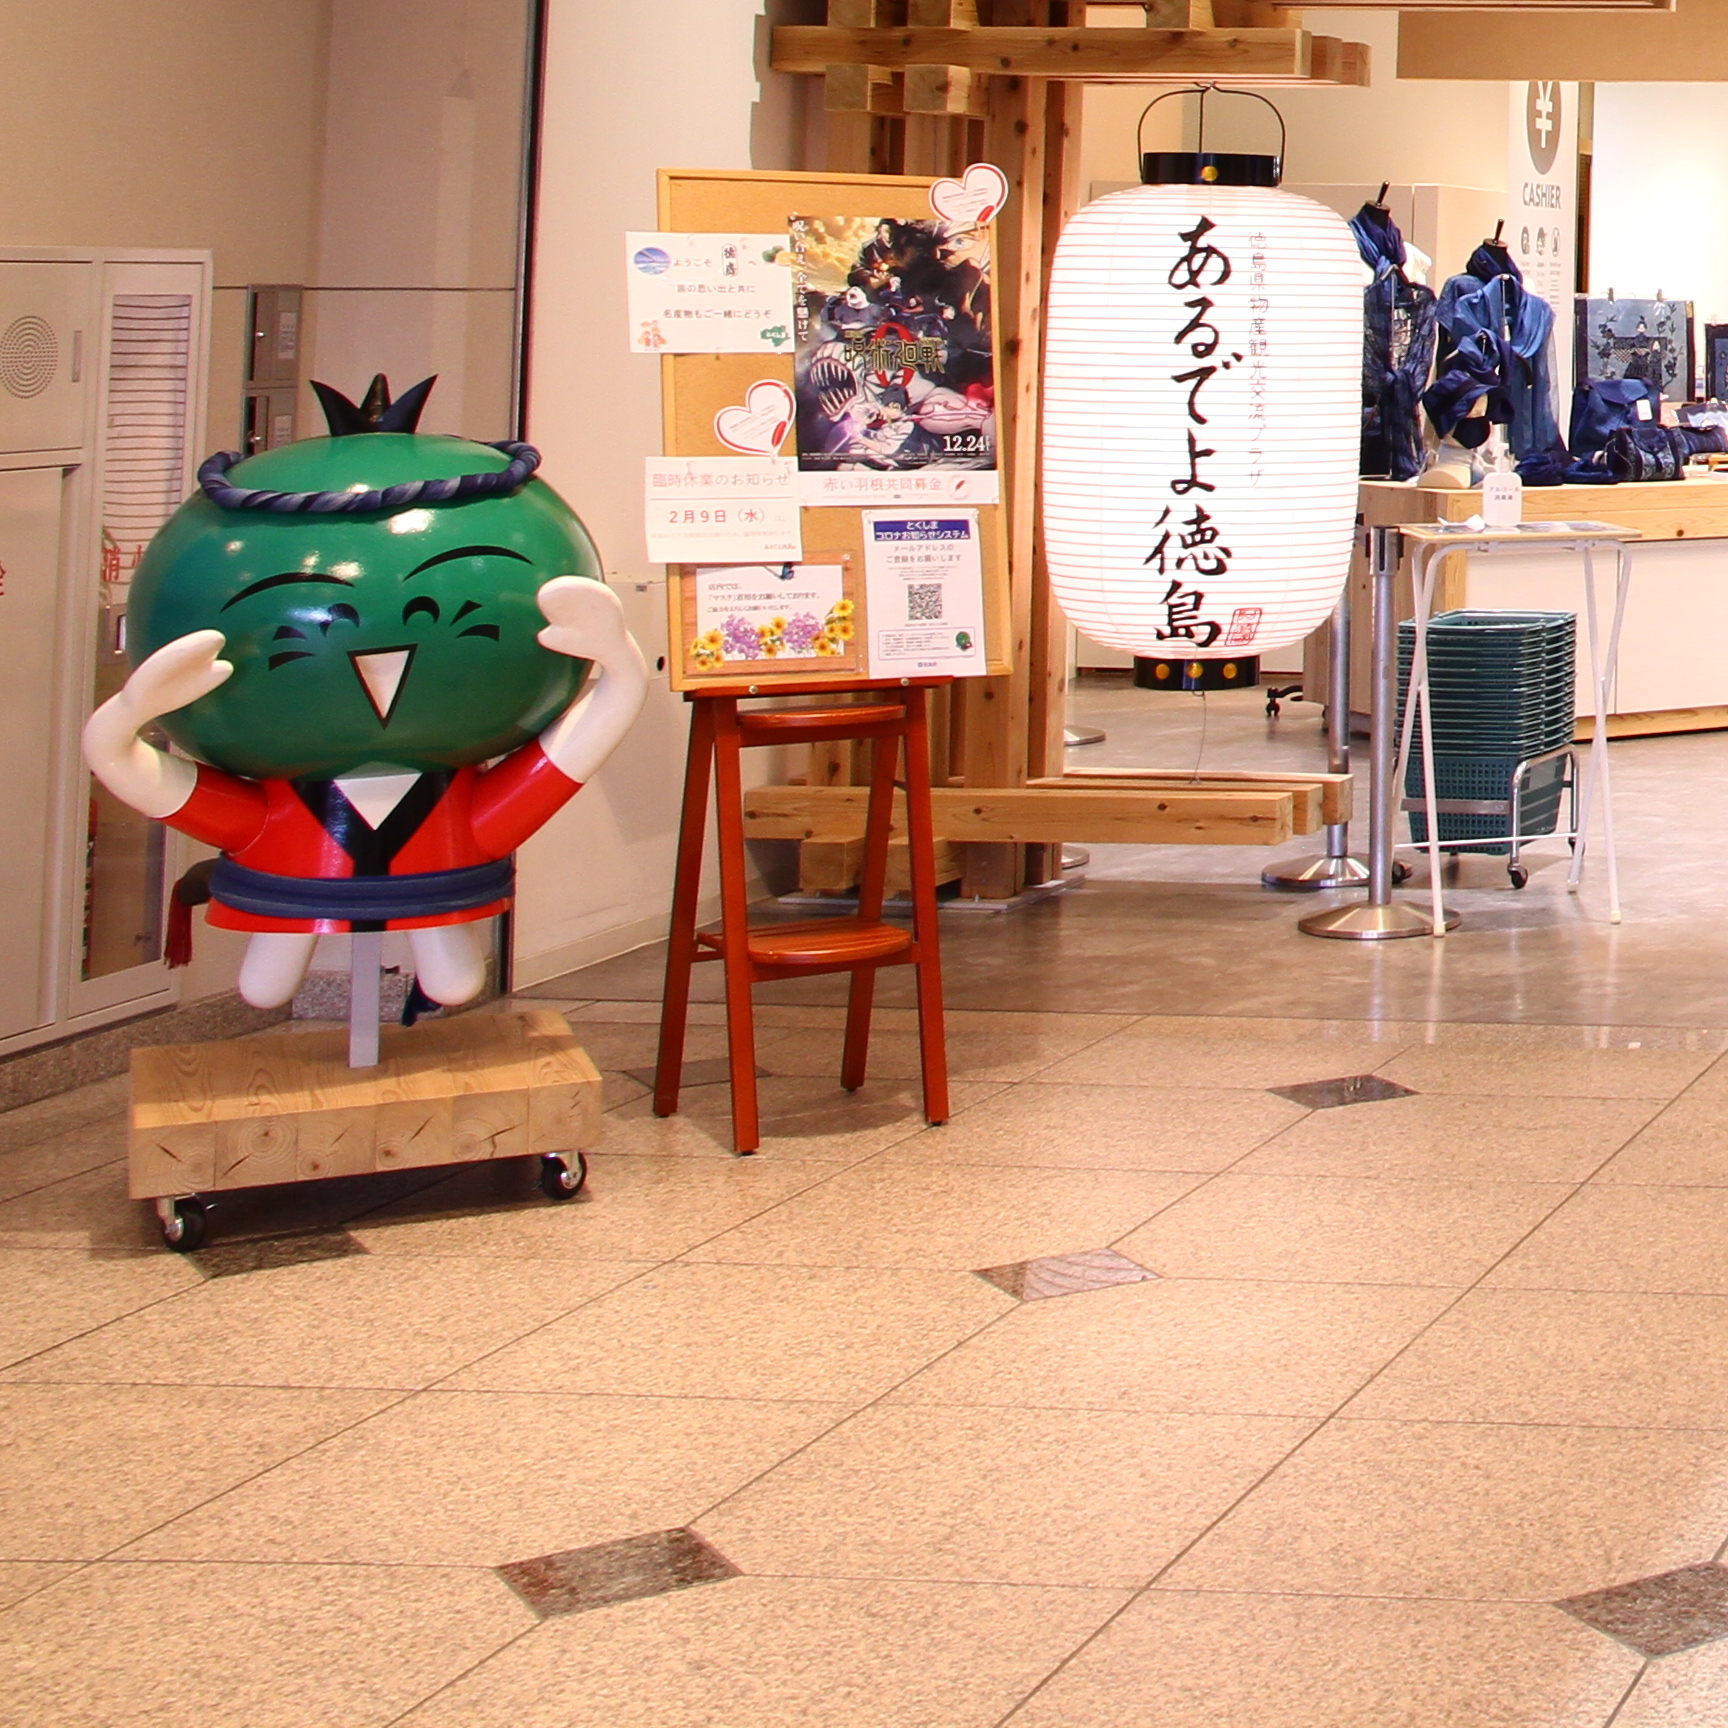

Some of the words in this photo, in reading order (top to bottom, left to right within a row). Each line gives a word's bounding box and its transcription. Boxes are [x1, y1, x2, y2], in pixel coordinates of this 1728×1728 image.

[1522, 182, 1561, 210] CASHIER
[673, 258, 712, 268] ようこそ
[663, 309, 771, 319] 名産物もご一緒にどうぞ
[1142, 215, 1243, 648] あるでよ徳島
[944, 435, 985, 452] 12.24
[652, 473, 788, 487] 臨時休業のお知らせ
[824, 477, 943, 491] 赤い羽根共同募金
[906, 521, 938, 530] とくしま
[875, 530, 969, 540] コロナお知らせシステム
[893, 544, 955, 552] メールアドレスの
[886, 554, 962, 563] ご登録をお願いします
